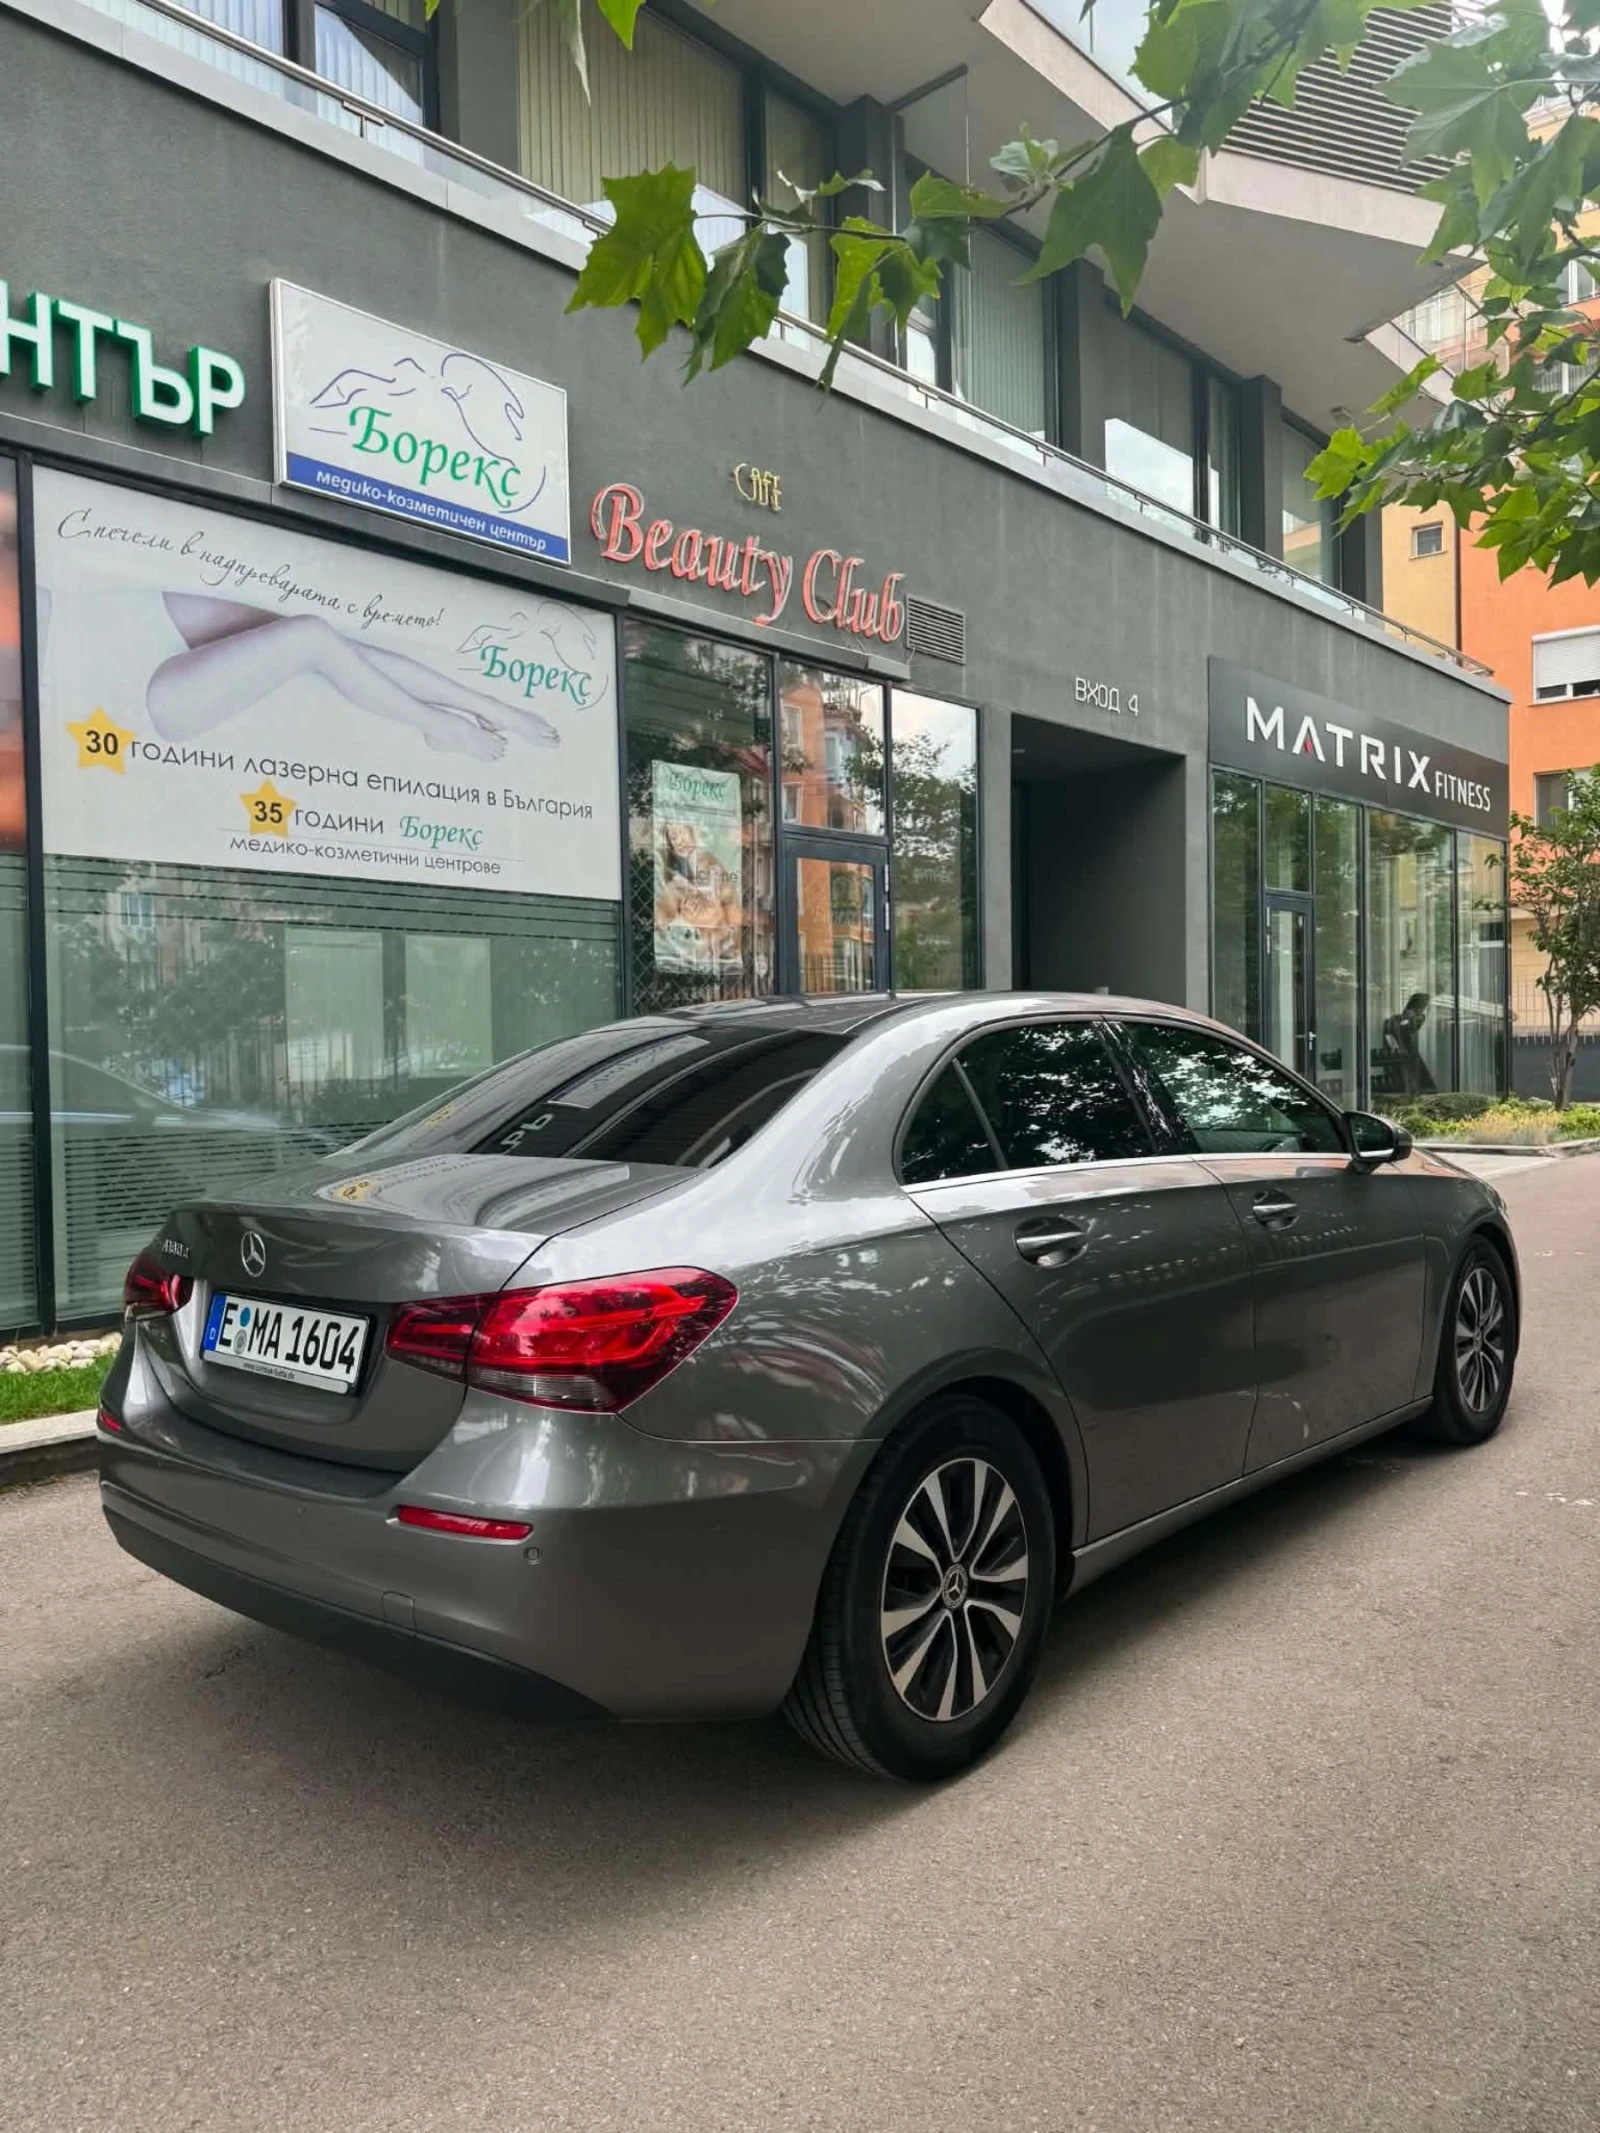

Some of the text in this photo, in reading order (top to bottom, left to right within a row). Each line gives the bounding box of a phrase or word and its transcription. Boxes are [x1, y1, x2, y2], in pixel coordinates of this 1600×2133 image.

[349, 405, 522, 508] Борекс
[316, 470, 547, 552] медико-козметичен център
[57, 508, 176, 551] Спечели
[180, 531, 204, 556] в
[200, 549, 341, 611] надпреварата
[346, 602, 359, 614] с
[589, 482, 906, 644] Beauty Club
[479, 644, 593, 706] Борекс
[1075, 676, 1139, 717] ВХОД 4
[85, 730, 594, 821] 30 години лазерна епилация в България
[1246, 696, 1492, 813] MATRIX FITNESS
[229, 837, 501, 875] медико-козметични центрове
[254, 800, 483, 851] 35 години Борекс
[218, 1302, 361, 1375] E MA 1604
